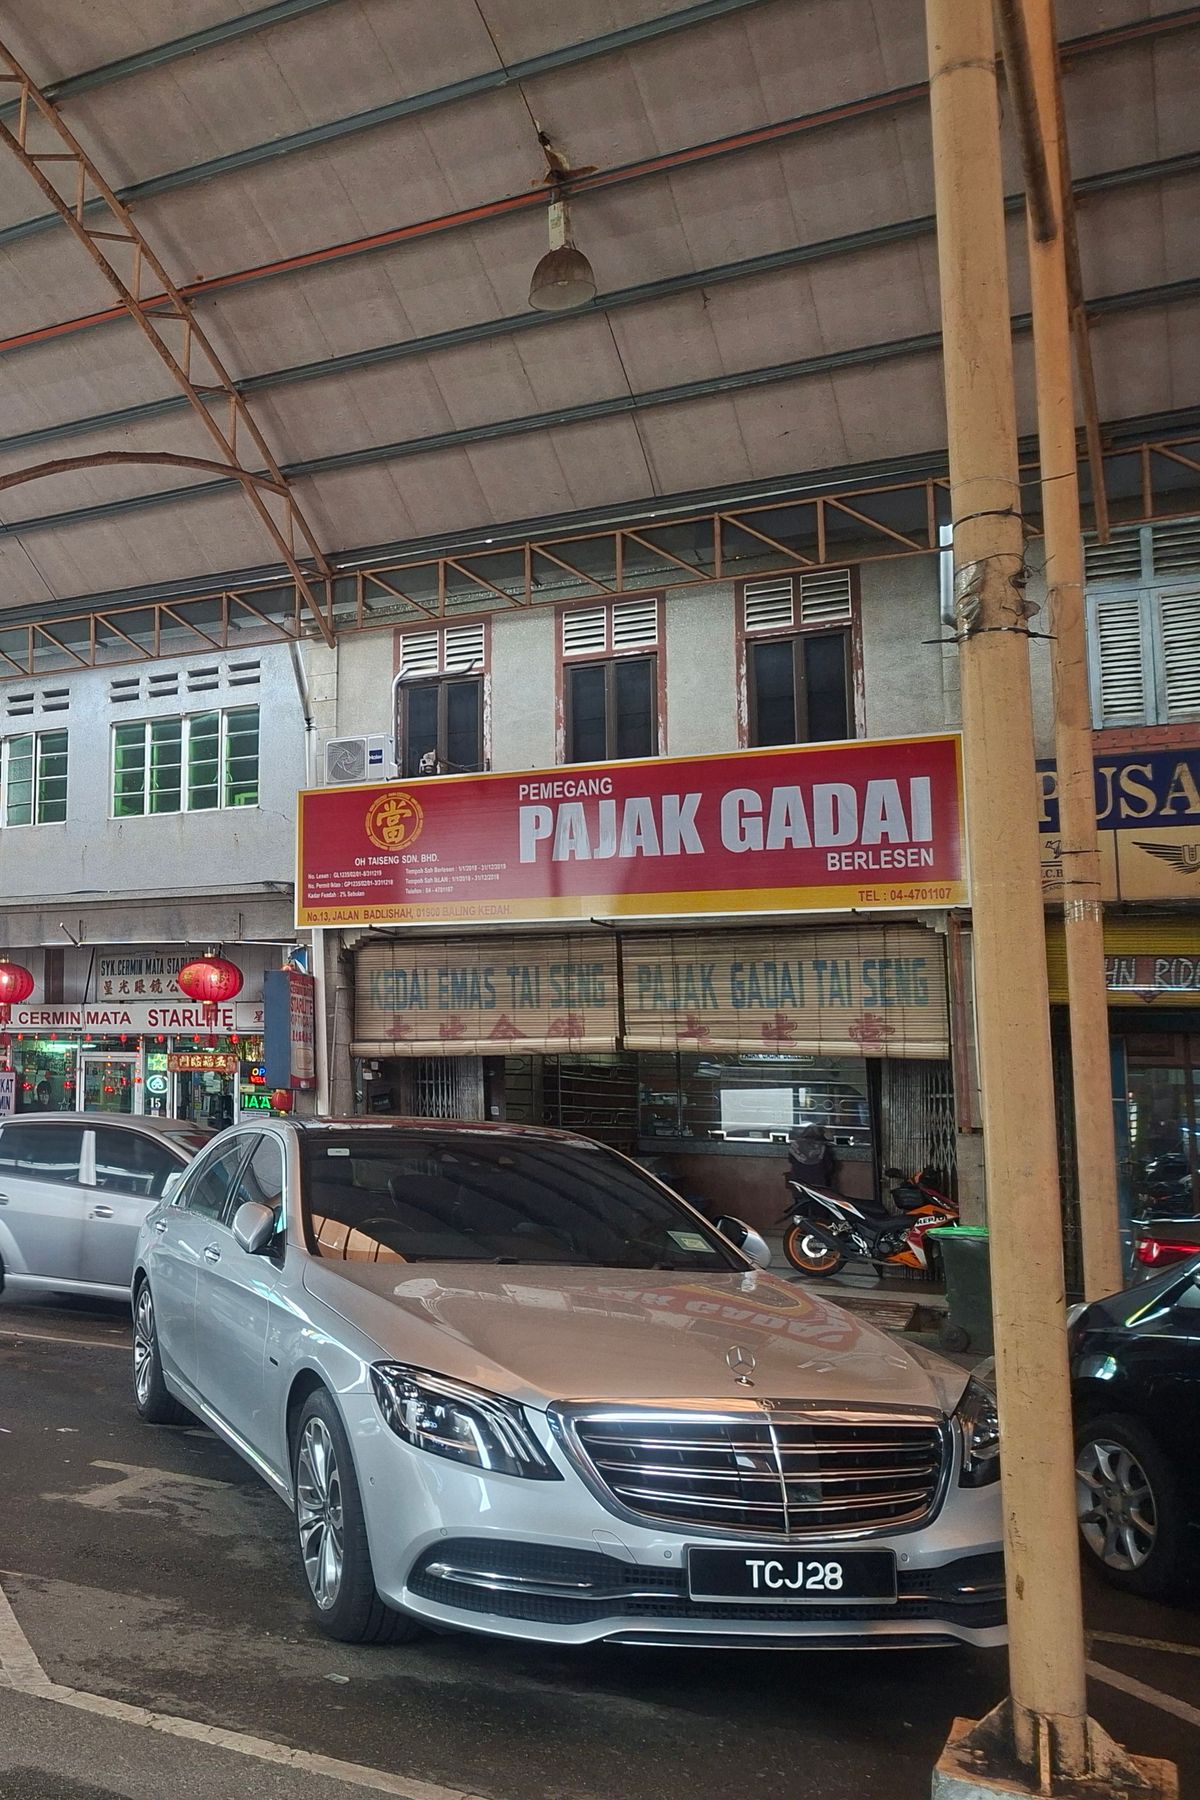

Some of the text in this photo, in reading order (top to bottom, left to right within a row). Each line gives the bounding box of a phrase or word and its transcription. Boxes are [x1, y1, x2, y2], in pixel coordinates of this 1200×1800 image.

[518, 777, 613, 800] PEMEGANG
[519, 776, 932, 863] PAJAK GADAI
[354, 853, 440, 866] OH TAISENG SDN. BHD.
[826, 848, 934, 871] BERLESEN
[858, 890, 880, 902] TEL
[889, 887, 952, 901] 04-4701107
[307, 904, 513, 922] No.13, JALAN BADLISHAH, 01900 BALING KEDAH.
[145, 959, 164, 974] MATA
[368, 963, 605, 1010] KEDAI EMAS TAI SENG
[634, 957, 930, 1010] PAJAK GADAI TAI SENG
[18, 1011, 81, 1025] CERMIN
[86, 1011, 132, 1025] MATA
[148, 1008, 234, 1027] STARLTE
[150, 1097, 161, 1108] 15
[745, 1559, 844, 1591] TCJ28
